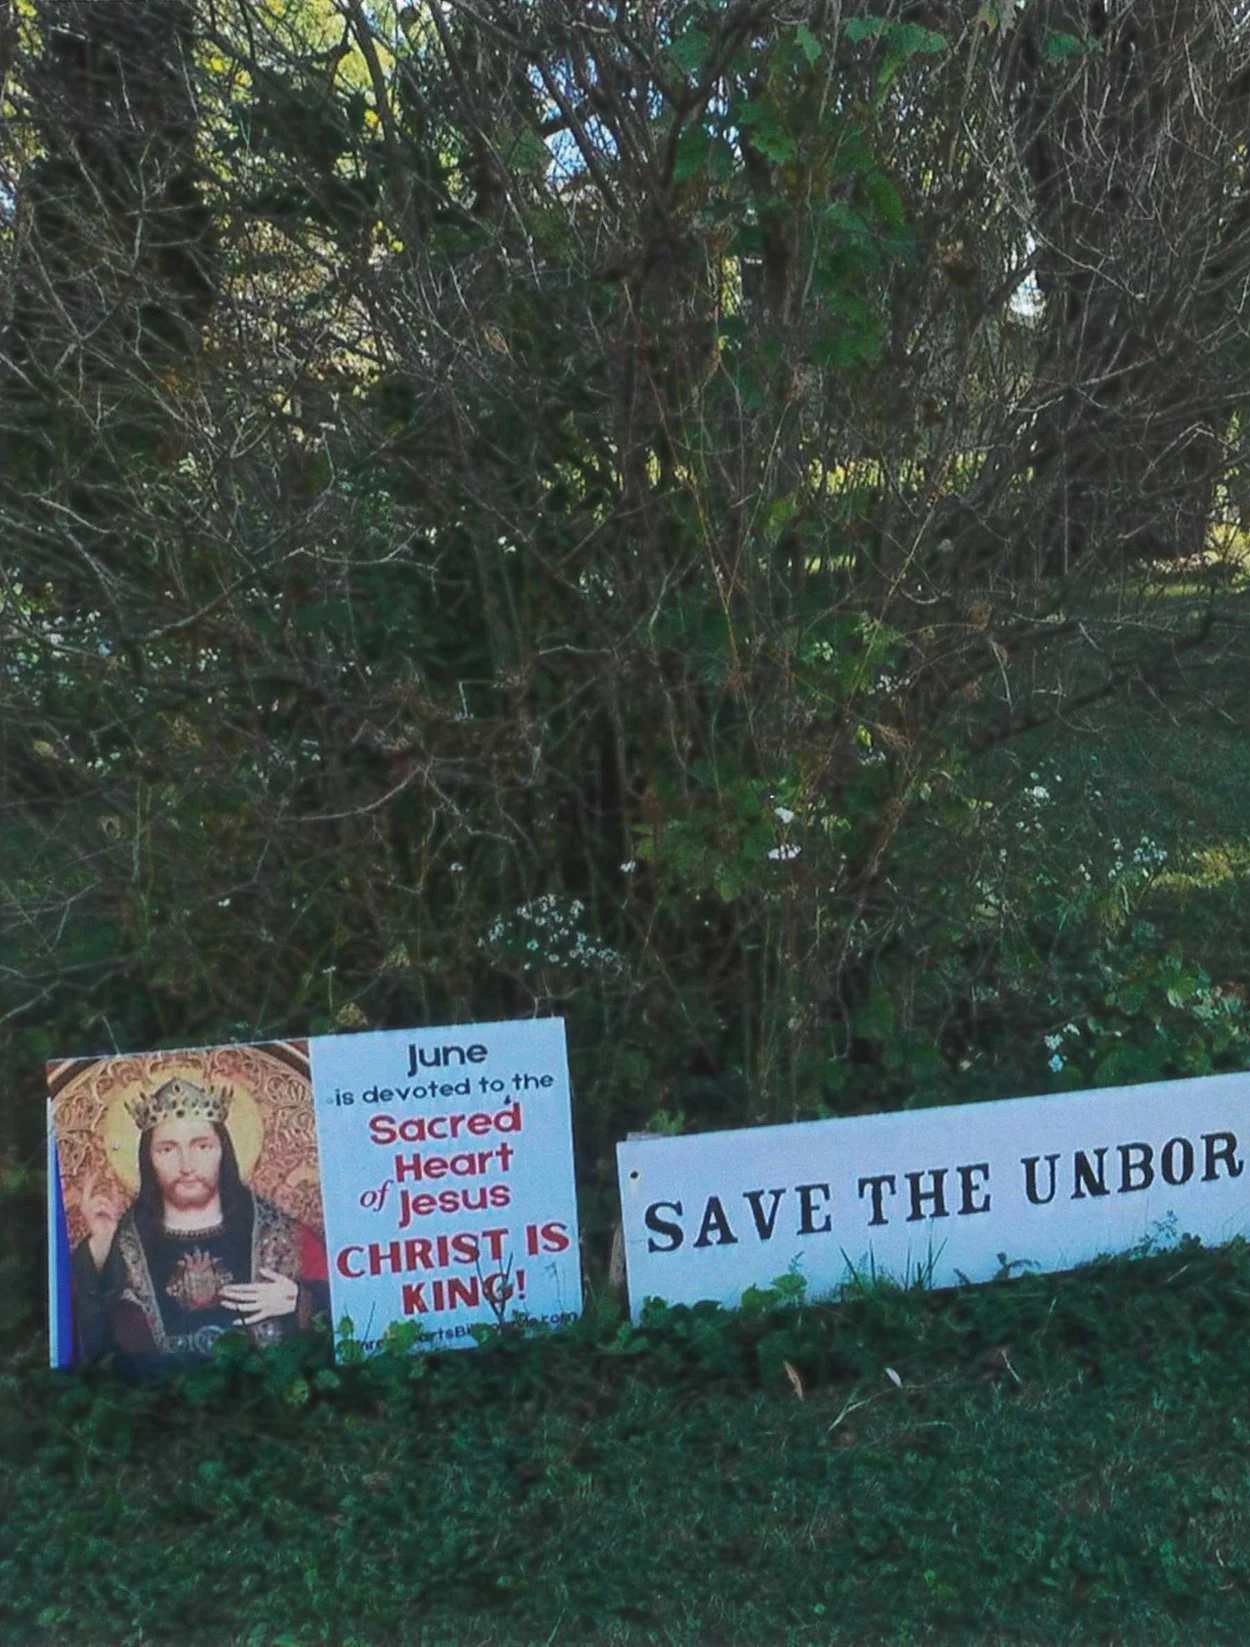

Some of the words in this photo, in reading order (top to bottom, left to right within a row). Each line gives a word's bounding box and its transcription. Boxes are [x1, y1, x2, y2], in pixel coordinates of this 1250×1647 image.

[407, 1044, 489, 1077] June
[335, 1088, 355, 1107] is
[362, 1078, 472, 1104] devoted
[480, 1076, 506, 1094] to
[513, 1073, 555, 1091] the
[369, 1102, 523, 1145] Sacred
[395, 1142, 515, 1183] Heart
[359, 1180, 394, 1212] of
[398, 1184, 512, 1229] Jesus
[644, 1183, 833, 1254] SAVE
[858, 1163, 992, 1226] THE
[336, 1228, 510, 1279] CHRIST
[526, 1222, 571, 1256] IS
[402, 1269, 527, 1316] KING!
